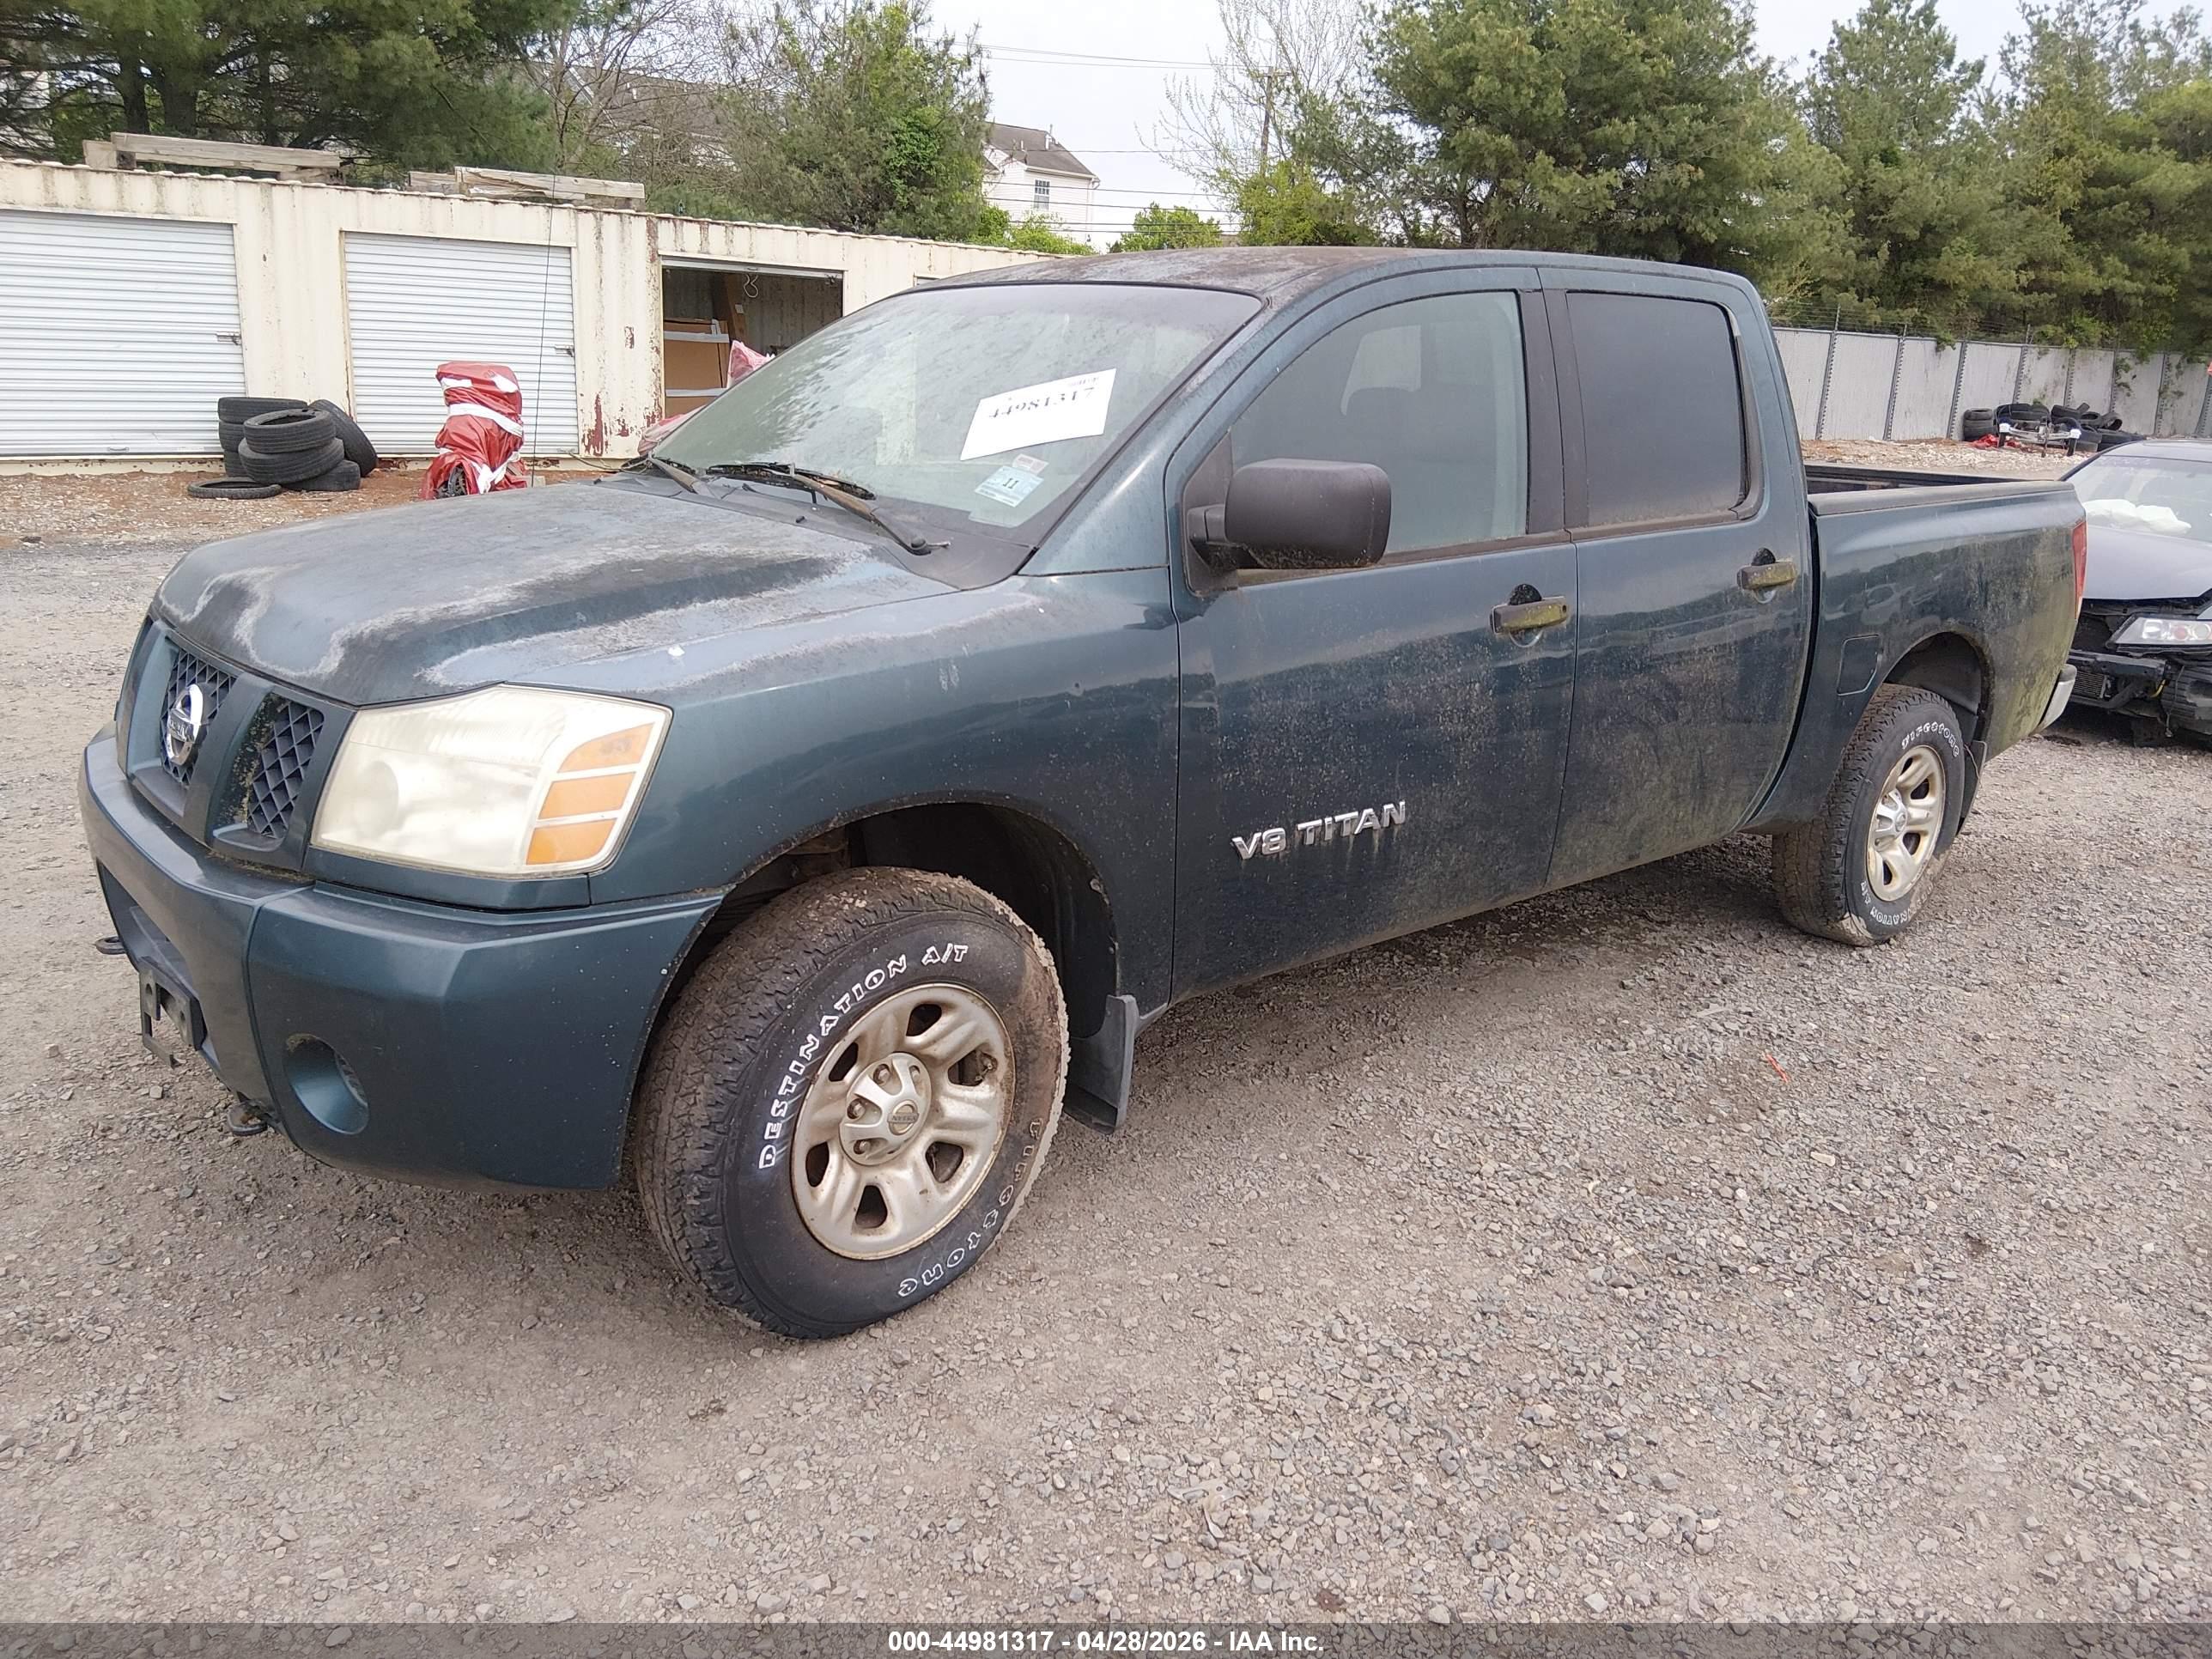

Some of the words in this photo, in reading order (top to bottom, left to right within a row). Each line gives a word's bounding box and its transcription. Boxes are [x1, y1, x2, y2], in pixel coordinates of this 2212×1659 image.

[1231, 827, 1286, 860] V8
[1297, 800, 1406, 845] TITAN
[758, 954, 907, 1170] DESTINATION
[921, 943, 969, 967] A/T
